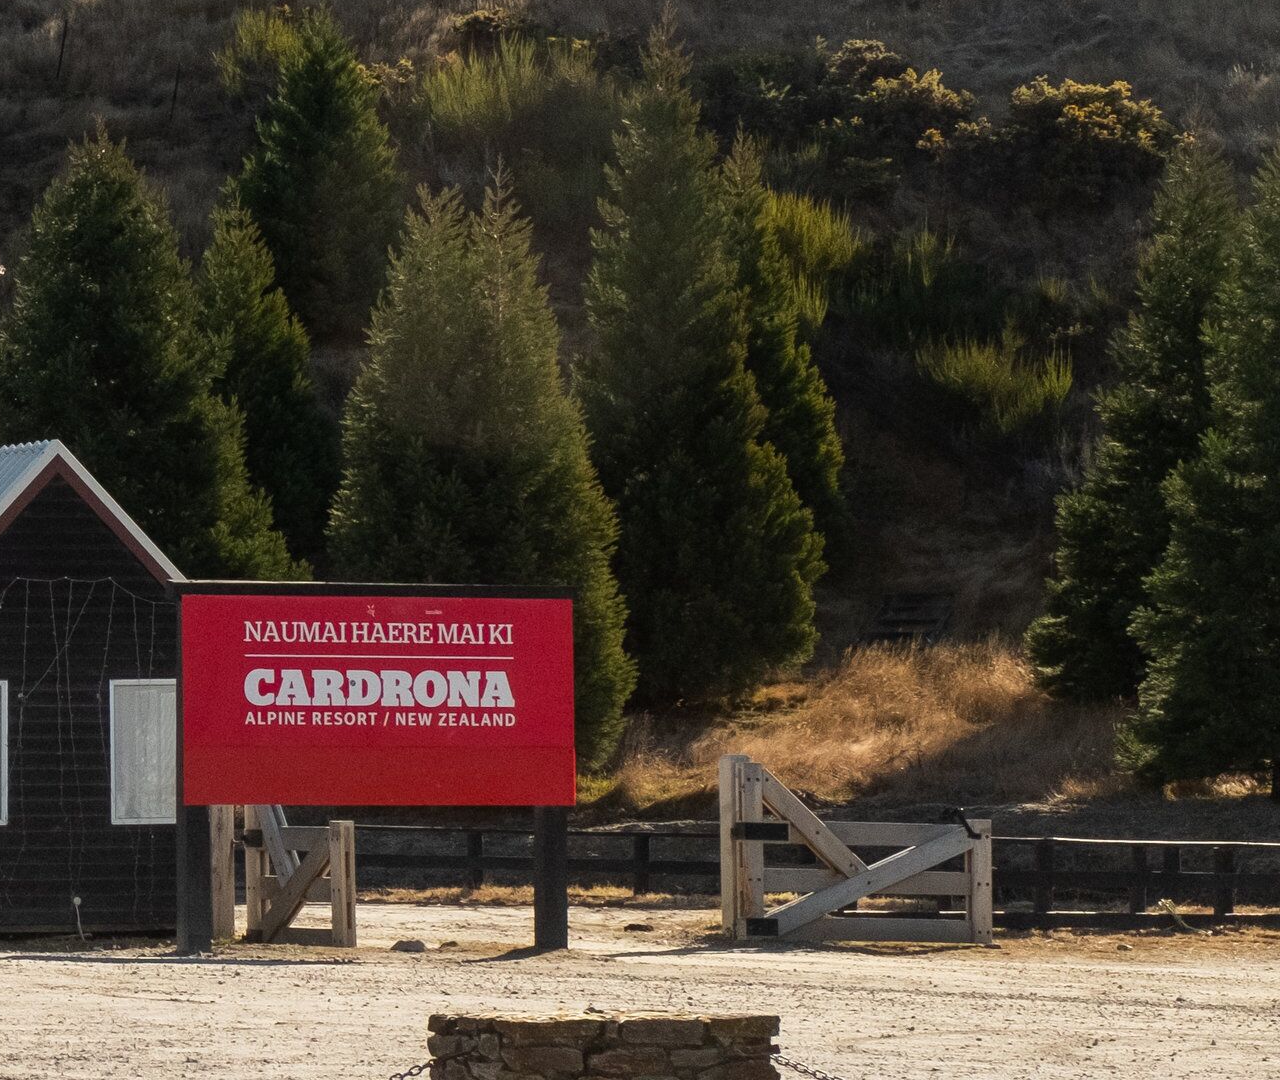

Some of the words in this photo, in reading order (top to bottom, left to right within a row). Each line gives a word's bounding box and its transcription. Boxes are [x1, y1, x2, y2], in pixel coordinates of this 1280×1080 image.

[350, 622, 433, 644] HAERE
[437, 623, 485, 645] MAI
[488, 623, 514, 645] KI
[243, 668, 516, 708] CARDRONA
[244, 711, 307, 726] ALPINE
[311, 711, 378, 726] RESORT
[395, 712, 433, 727] NEW
[437, 712, 516, 727] ZEALAND
